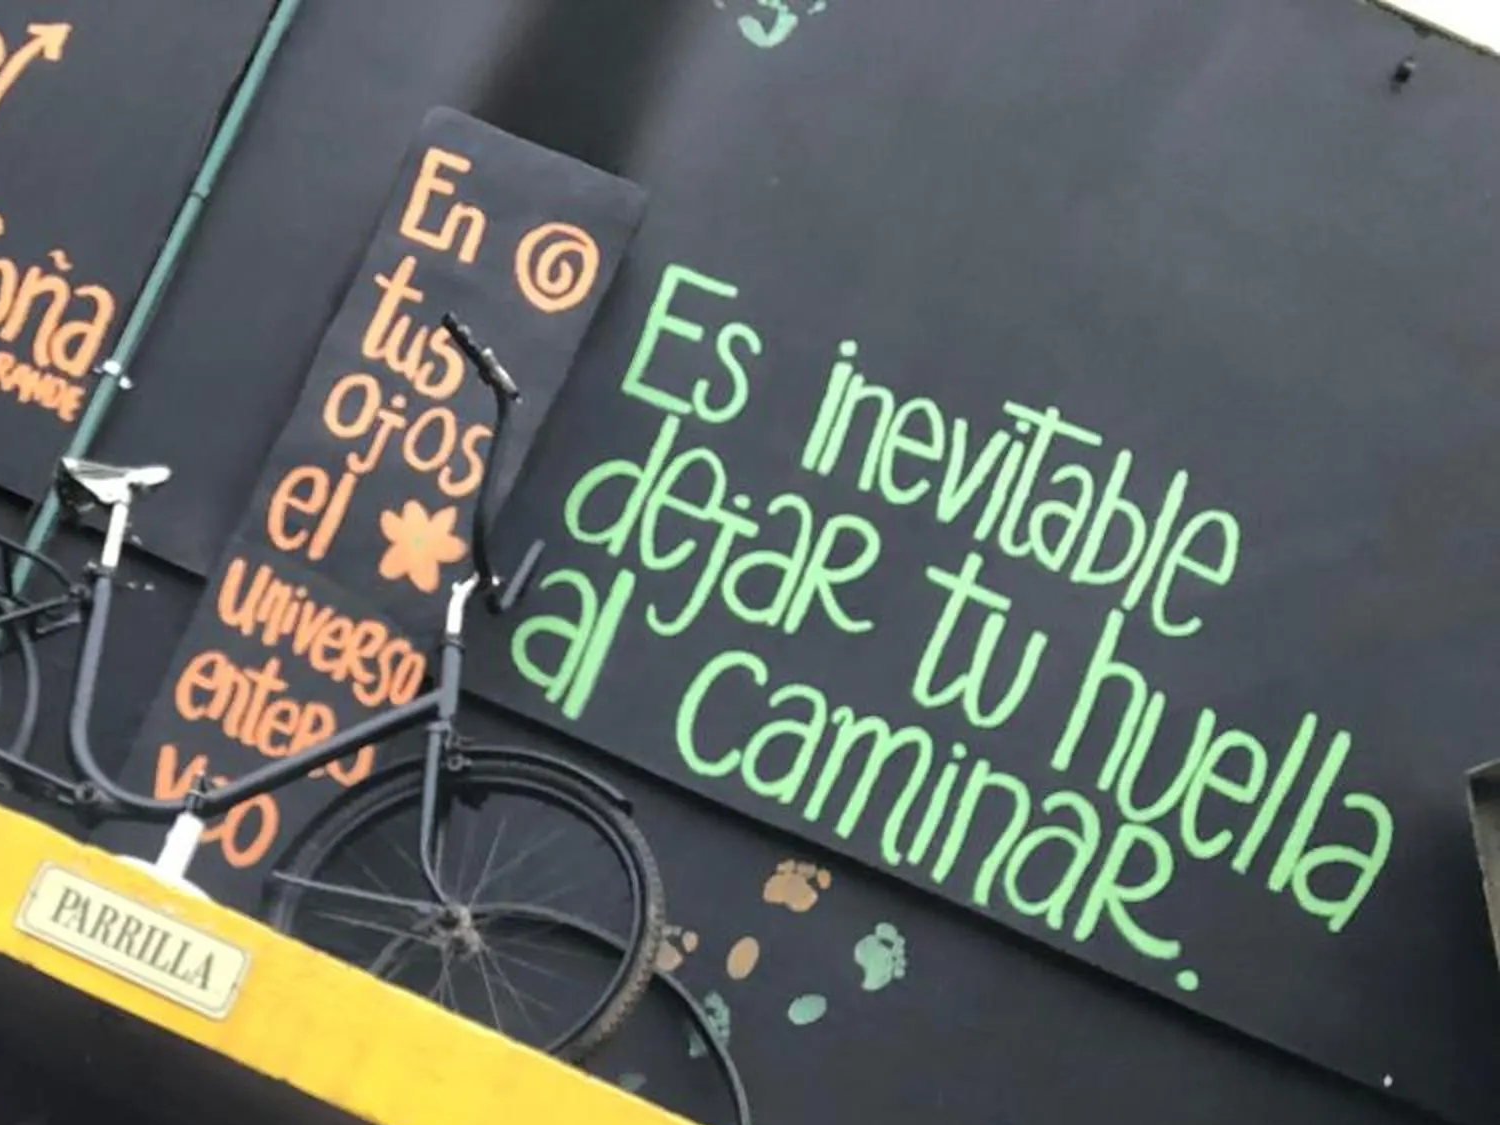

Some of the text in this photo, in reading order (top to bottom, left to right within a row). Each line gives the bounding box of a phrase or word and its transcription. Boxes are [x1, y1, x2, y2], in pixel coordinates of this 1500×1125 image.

[399, 146, 487, 264] En
[361, 254, 466, 399] tus
[267, 465, 357, 560] el
[621, 263, 1241, 638] Es inevitable
[509, 567, 635, 720] al
[912, 553, 1048, 729] tu
[1051, 609, 1394, 934] huella
[50, 887, 215, 991] PARRILLA
